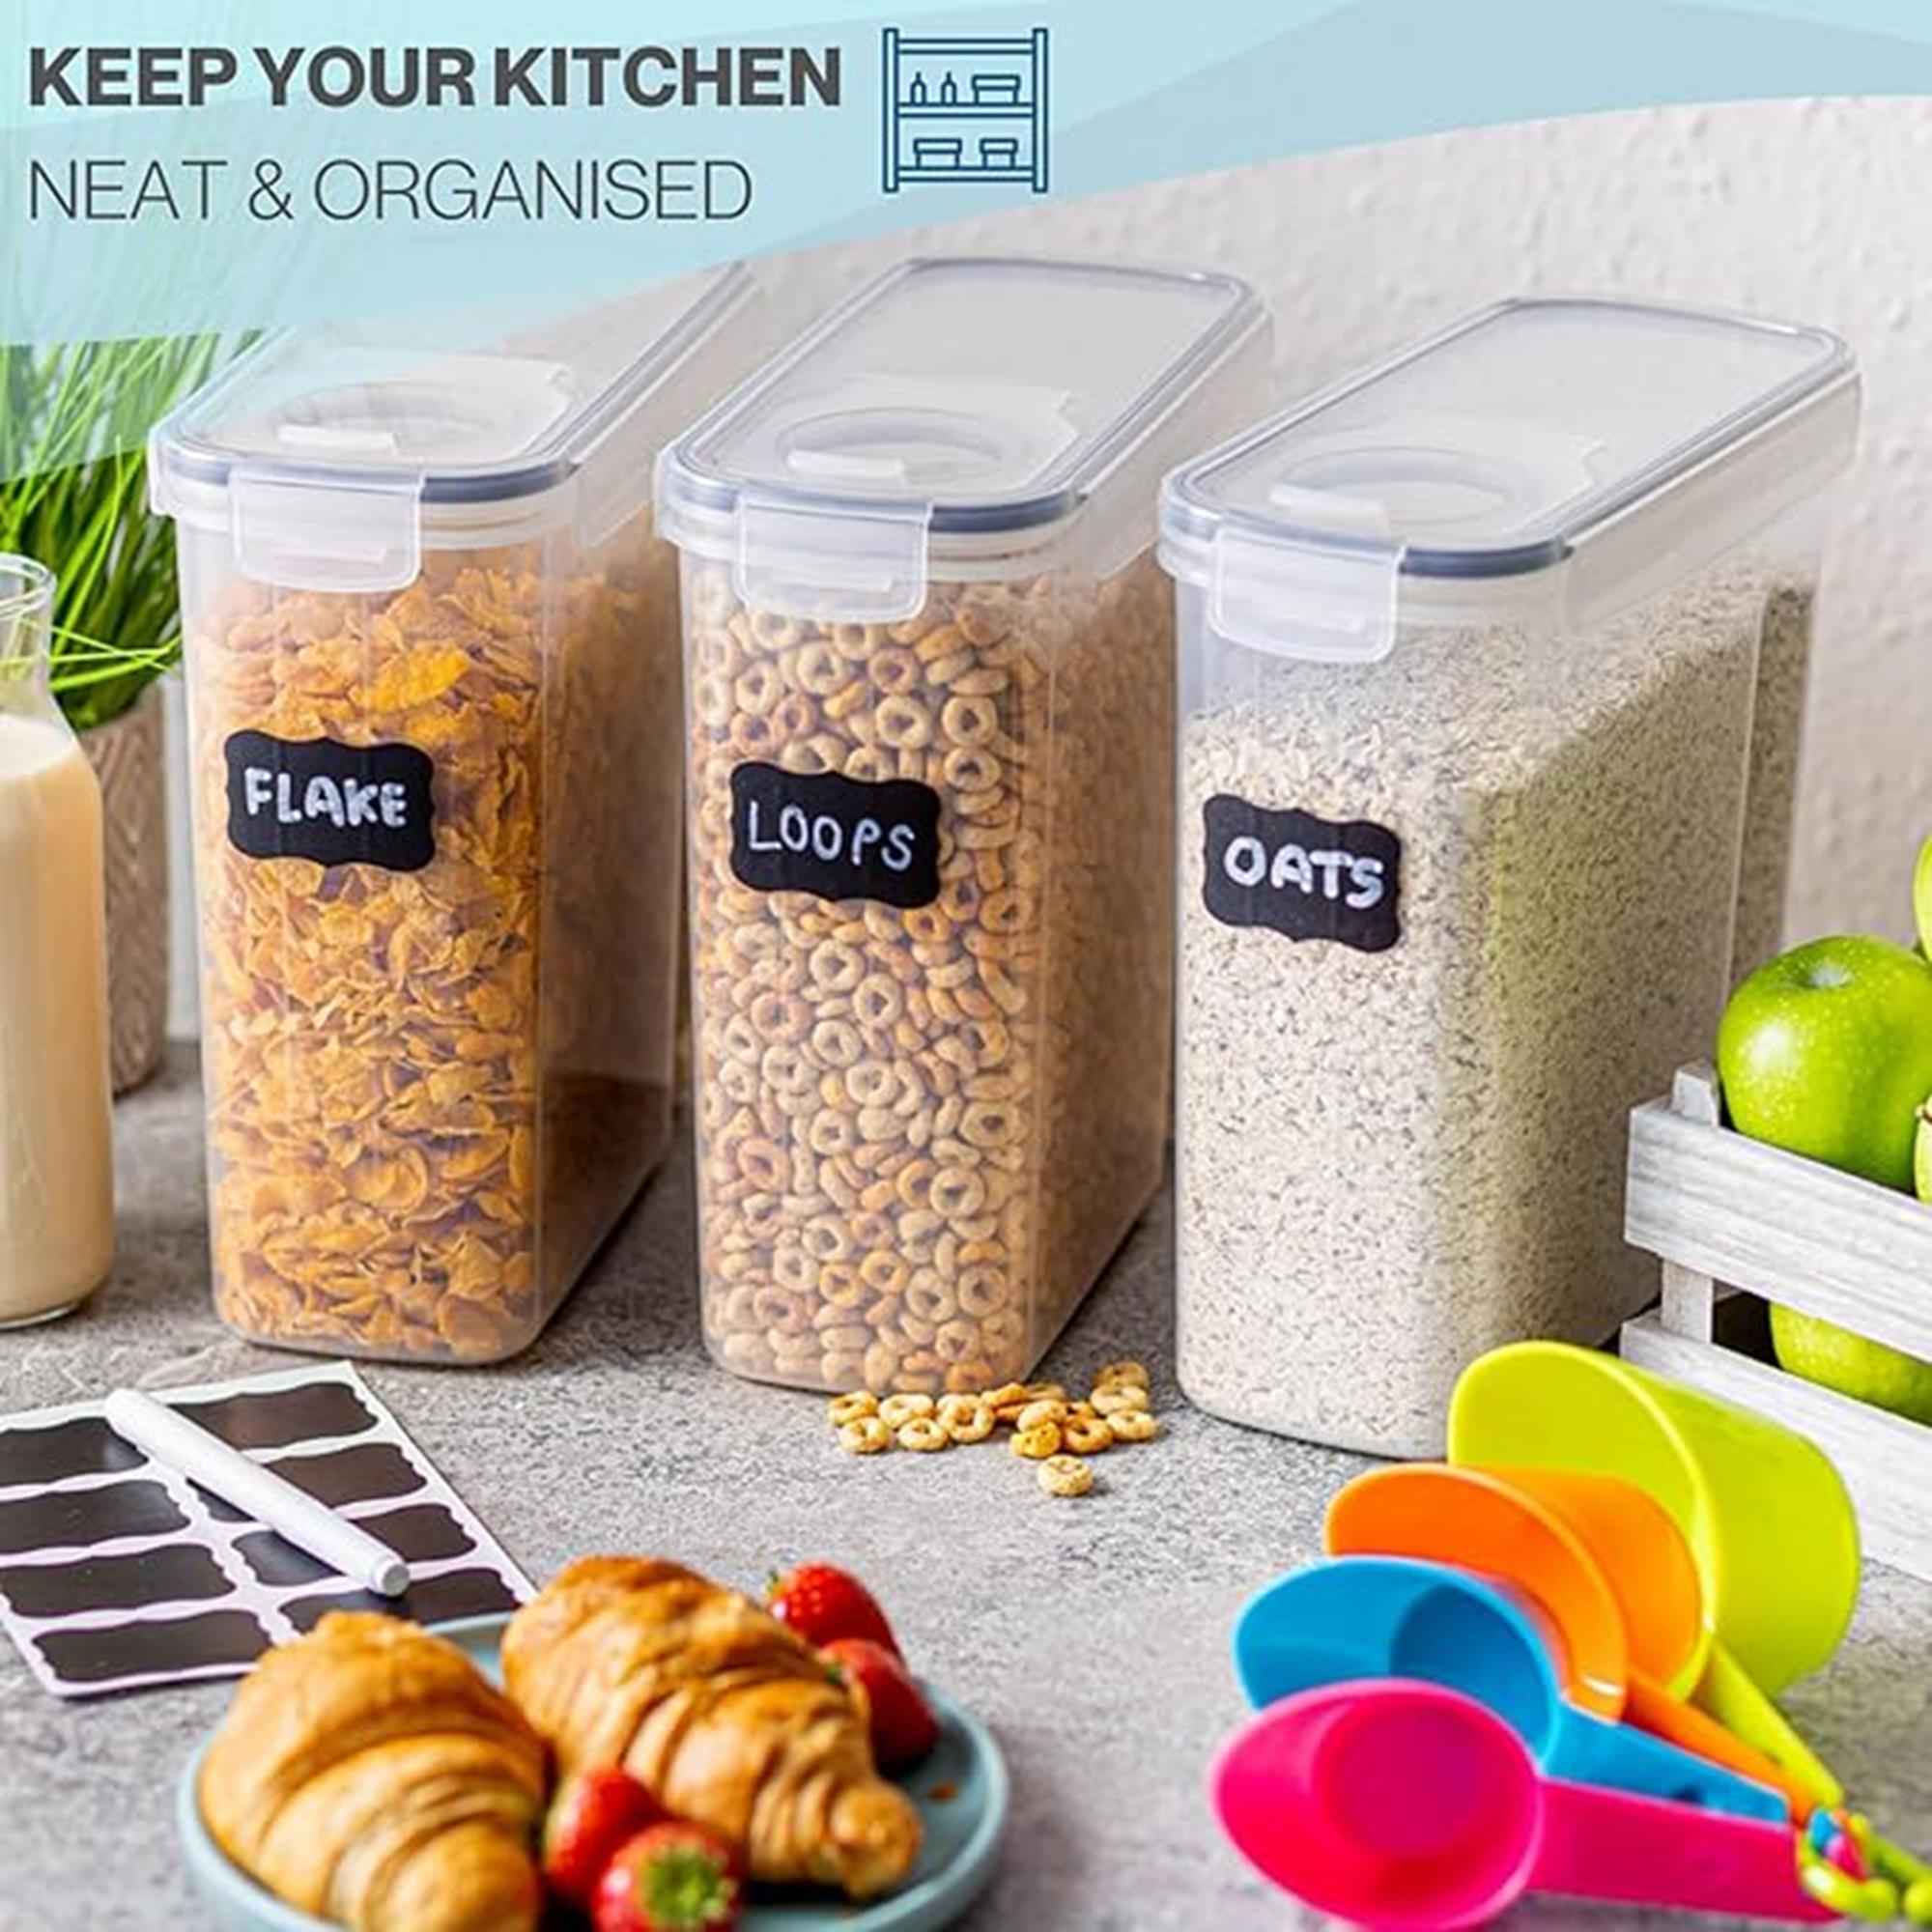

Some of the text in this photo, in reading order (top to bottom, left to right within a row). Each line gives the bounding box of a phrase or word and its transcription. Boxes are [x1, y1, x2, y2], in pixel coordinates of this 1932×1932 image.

[243, 766, 407, 828] FLAKE
[749, 800, 916, 871] LOOPS
[1223, 837, 1384, 909] OATS
